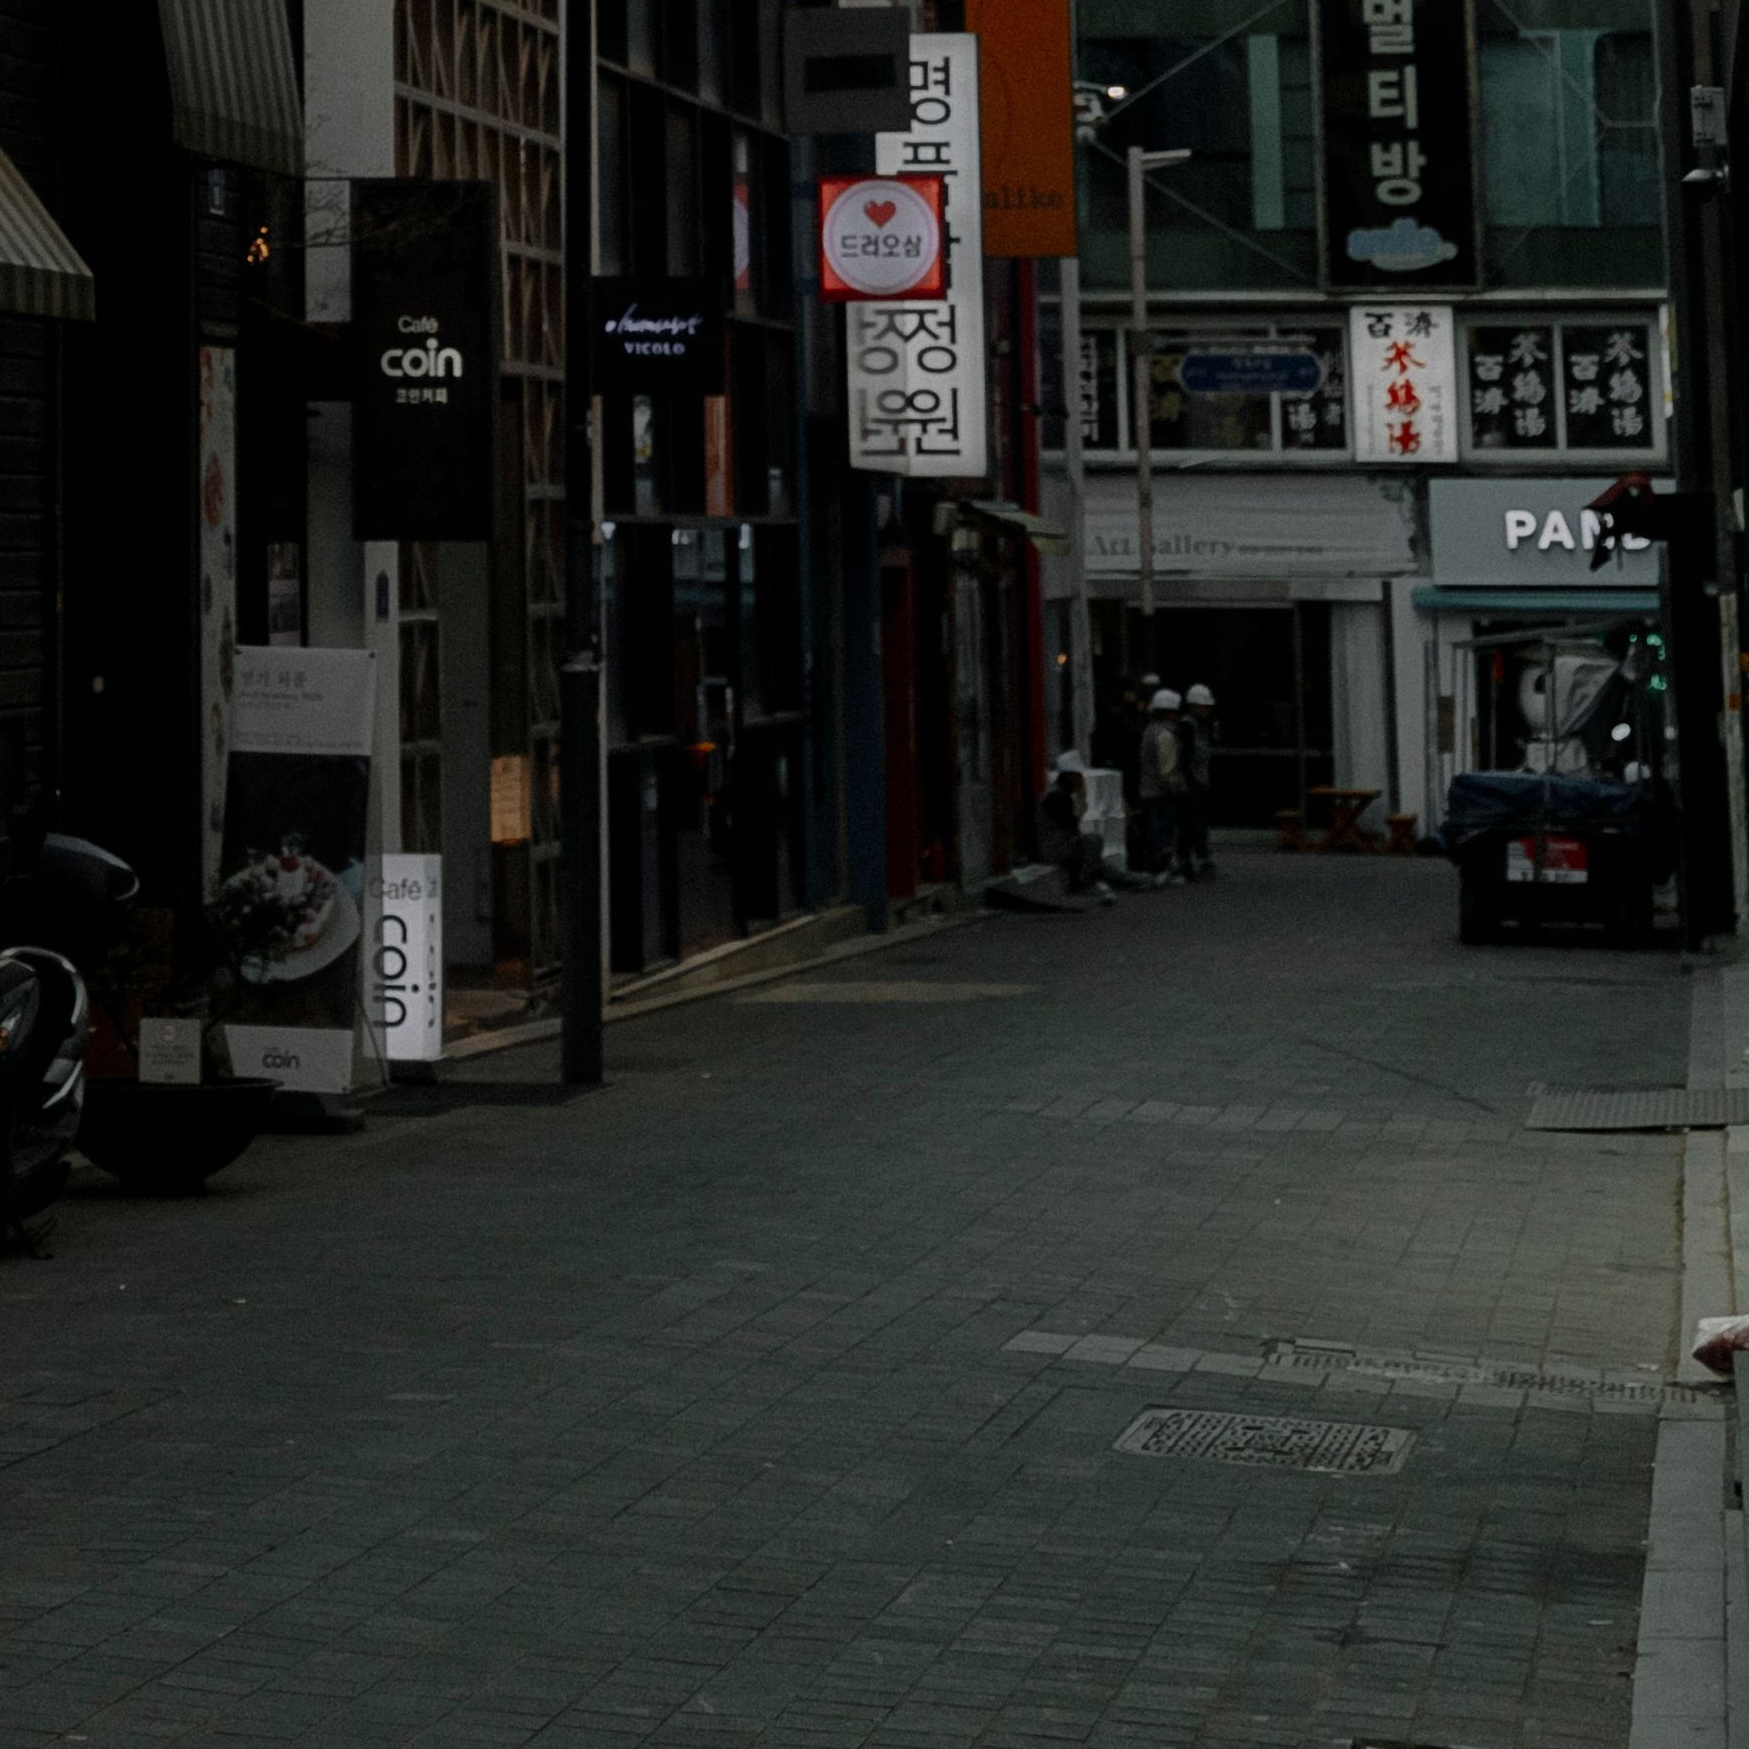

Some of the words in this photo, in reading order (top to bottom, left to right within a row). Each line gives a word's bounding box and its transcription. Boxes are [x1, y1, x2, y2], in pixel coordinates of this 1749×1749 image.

[397, 314, 440, 334] Café
[380, 337, 464, 378] coin
[623, 341, 687, 356] VICOLO
[1090, 535, 1132, 557] Art
[1140, 534, 1233, 559] allery
[368, 877, 422, 901] Café
[372, 914, 420, 1029] coin
[261, 1051, 300, 1070] coin
